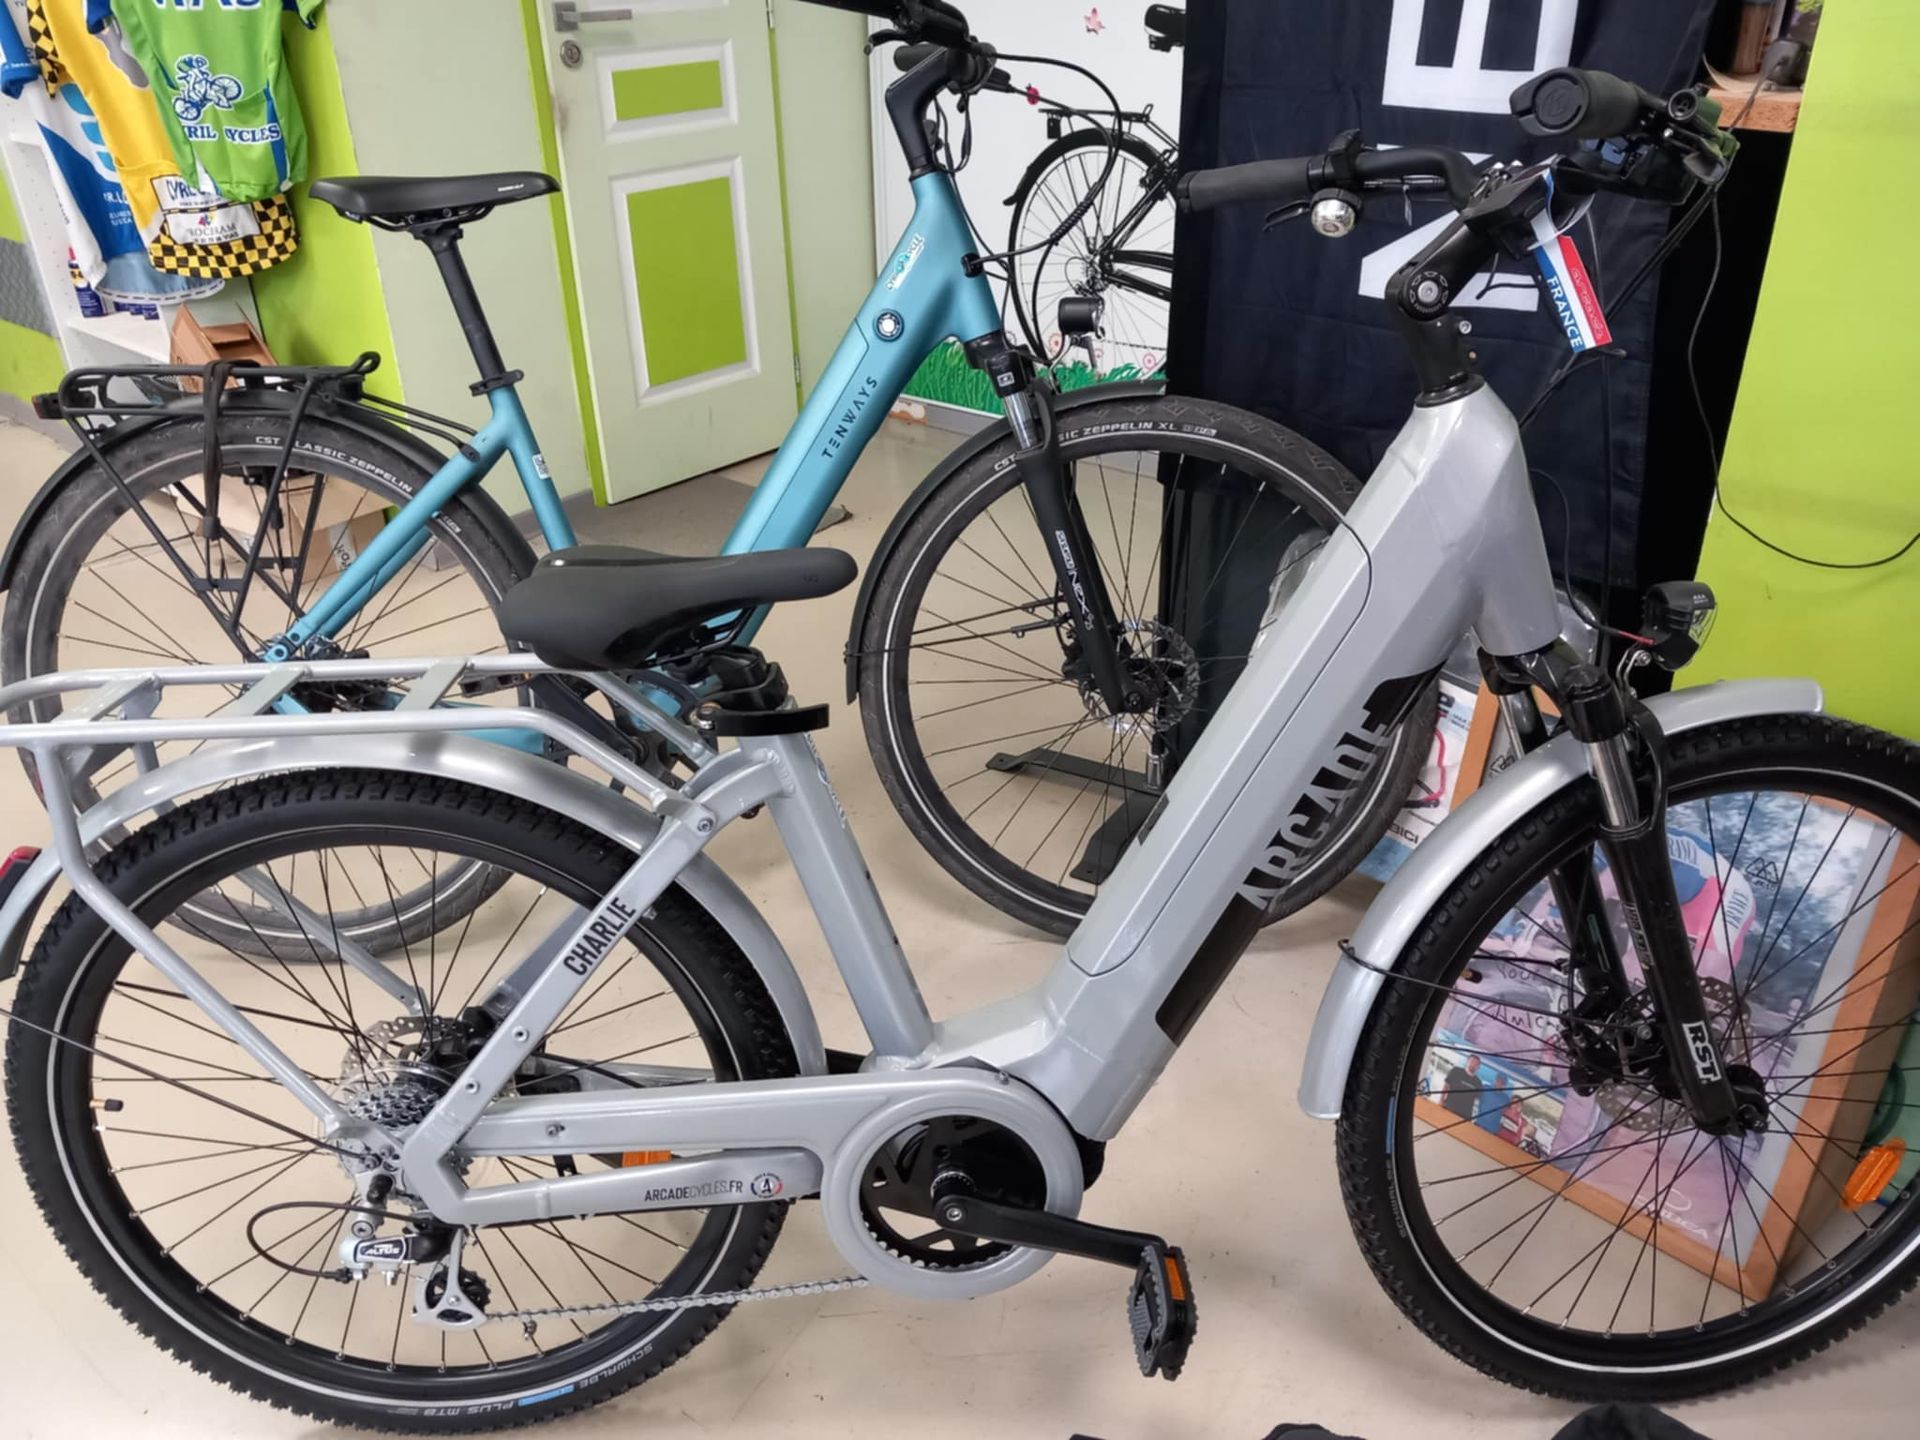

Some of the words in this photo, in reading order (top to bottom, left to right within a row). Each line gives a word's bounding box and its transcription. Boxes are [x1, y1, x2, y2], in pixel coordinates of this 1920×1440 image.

[1547, 275, 1583, 348] FRANCE
[821, 376, 877, 458] TENWAYS
[255, 435, 280, 446] CST
[293, 440, 347, 461] LASSIC
[349, 456, 413, 494] ZEPPELIN
[994, 452, 1018, 472] CST
[1083, 421, 1154, 435] ZEPPELIN
[1157, 421, 1177, 432] XL
[563, 897, 636, 976] CHARLIE
[1684, 1024, 1720, 1081] RST
[644, 1180, 744, 1201] ARCADECYCLES.FR
[578, 1343, 654, 1389] SCHWALBE
[423, 1406, 462, 1417] MTB
[466, 1400, 515, 1416] PLUS
